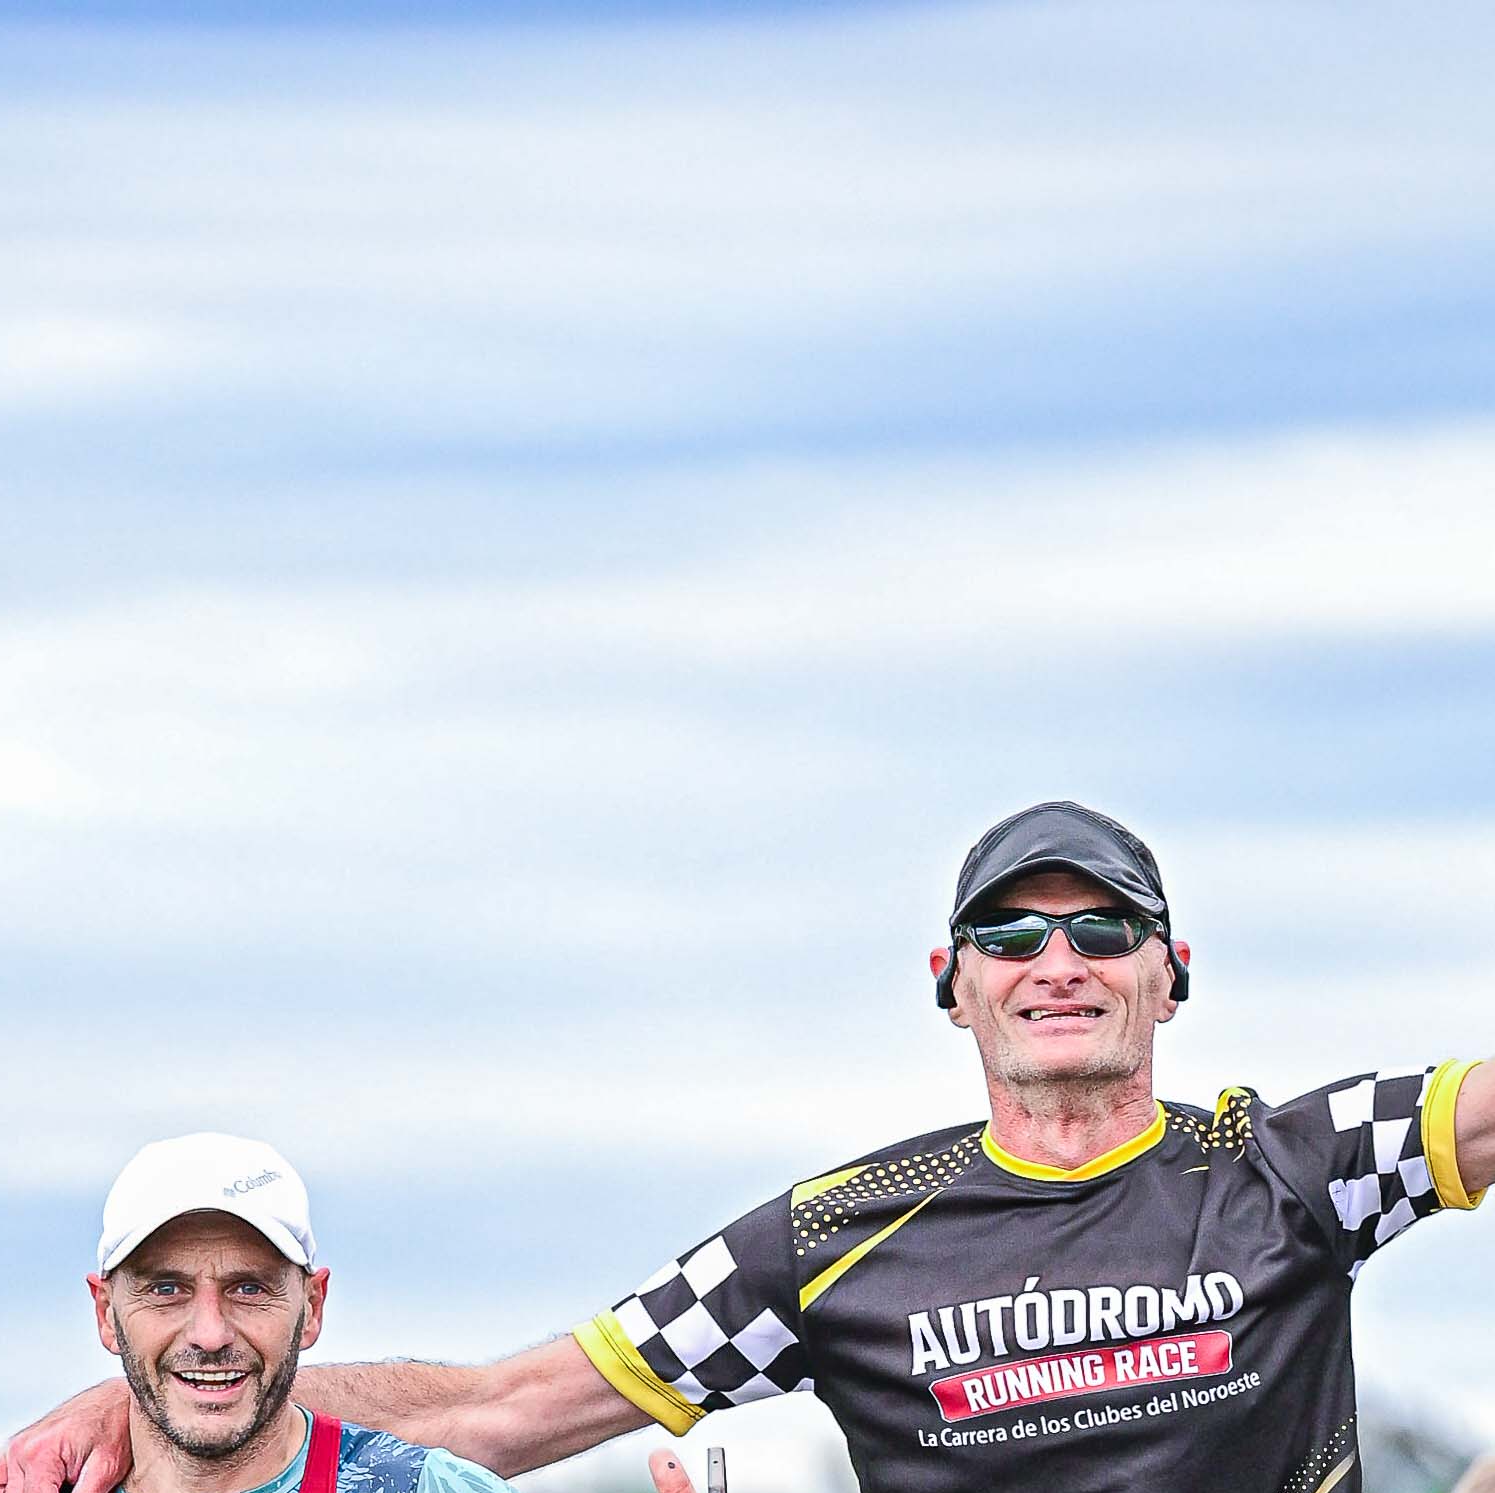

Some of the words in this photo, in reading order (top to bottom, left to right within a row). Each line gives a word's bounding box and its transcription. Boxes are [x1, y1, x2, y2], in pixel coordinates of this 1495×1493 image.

[907, 1271, 1245, 1377] AUTÓDROMO
[917, 1428, 939, 1448] La
[940, 1425, 1007, 1448] Carrera
[1011, 1419, 1038, 1439] de
[1040, 1415, 1071, 1436] los
[1073, 1402, 1143, 1431] Clubes
[1145, 1392, 1179, 1417] del
[1181, 1370, 1261, 1408] Noroeste
[961, 1354, 1105, 1414] RUNNING
[1113, 1340, 1200, 1384] RACE
